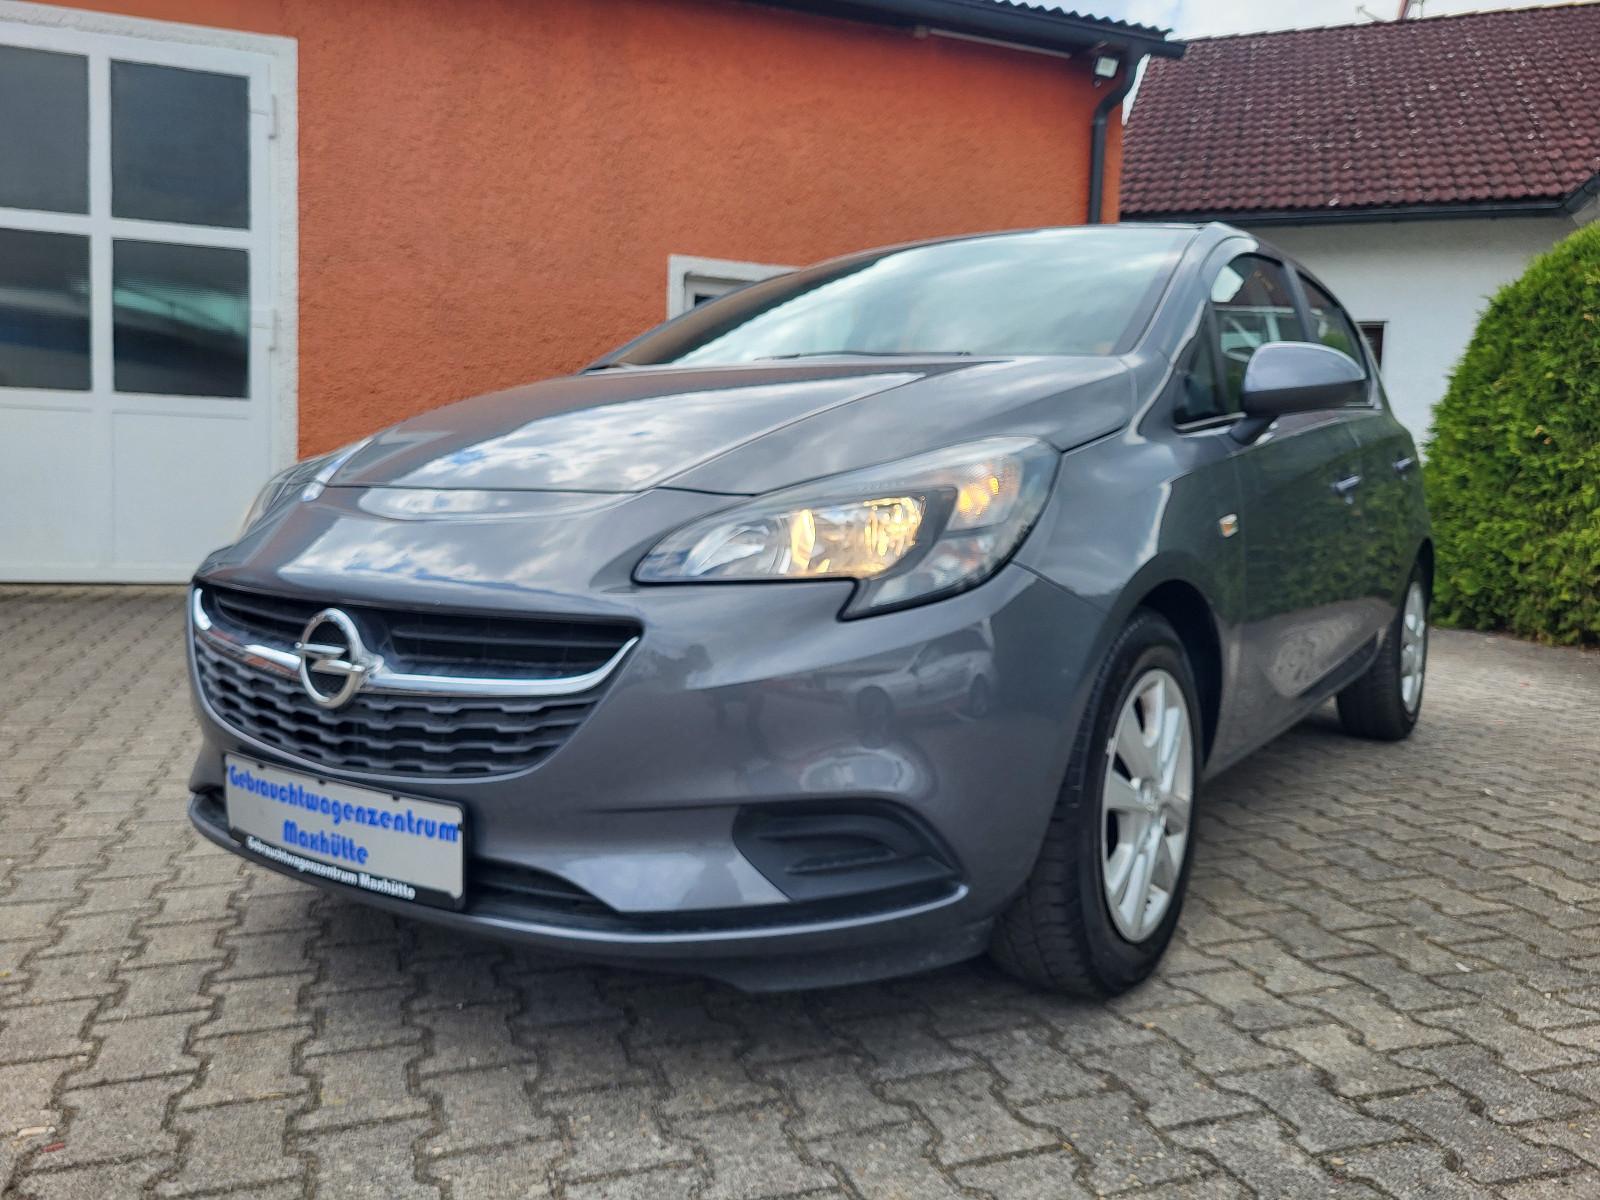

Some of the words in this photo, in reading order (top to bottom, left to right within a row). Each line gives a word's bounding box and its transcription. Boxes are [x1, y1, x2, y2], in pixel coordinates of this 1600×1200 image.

[228, 764, 458, 842] Gebrauchtwagenzentrum
[247, 836, 357, 885] Gebrauchtwagenzentrum
[359, 873, 416, 900] Maxhütte
[283, 820, 368, 864] Maxhütte
